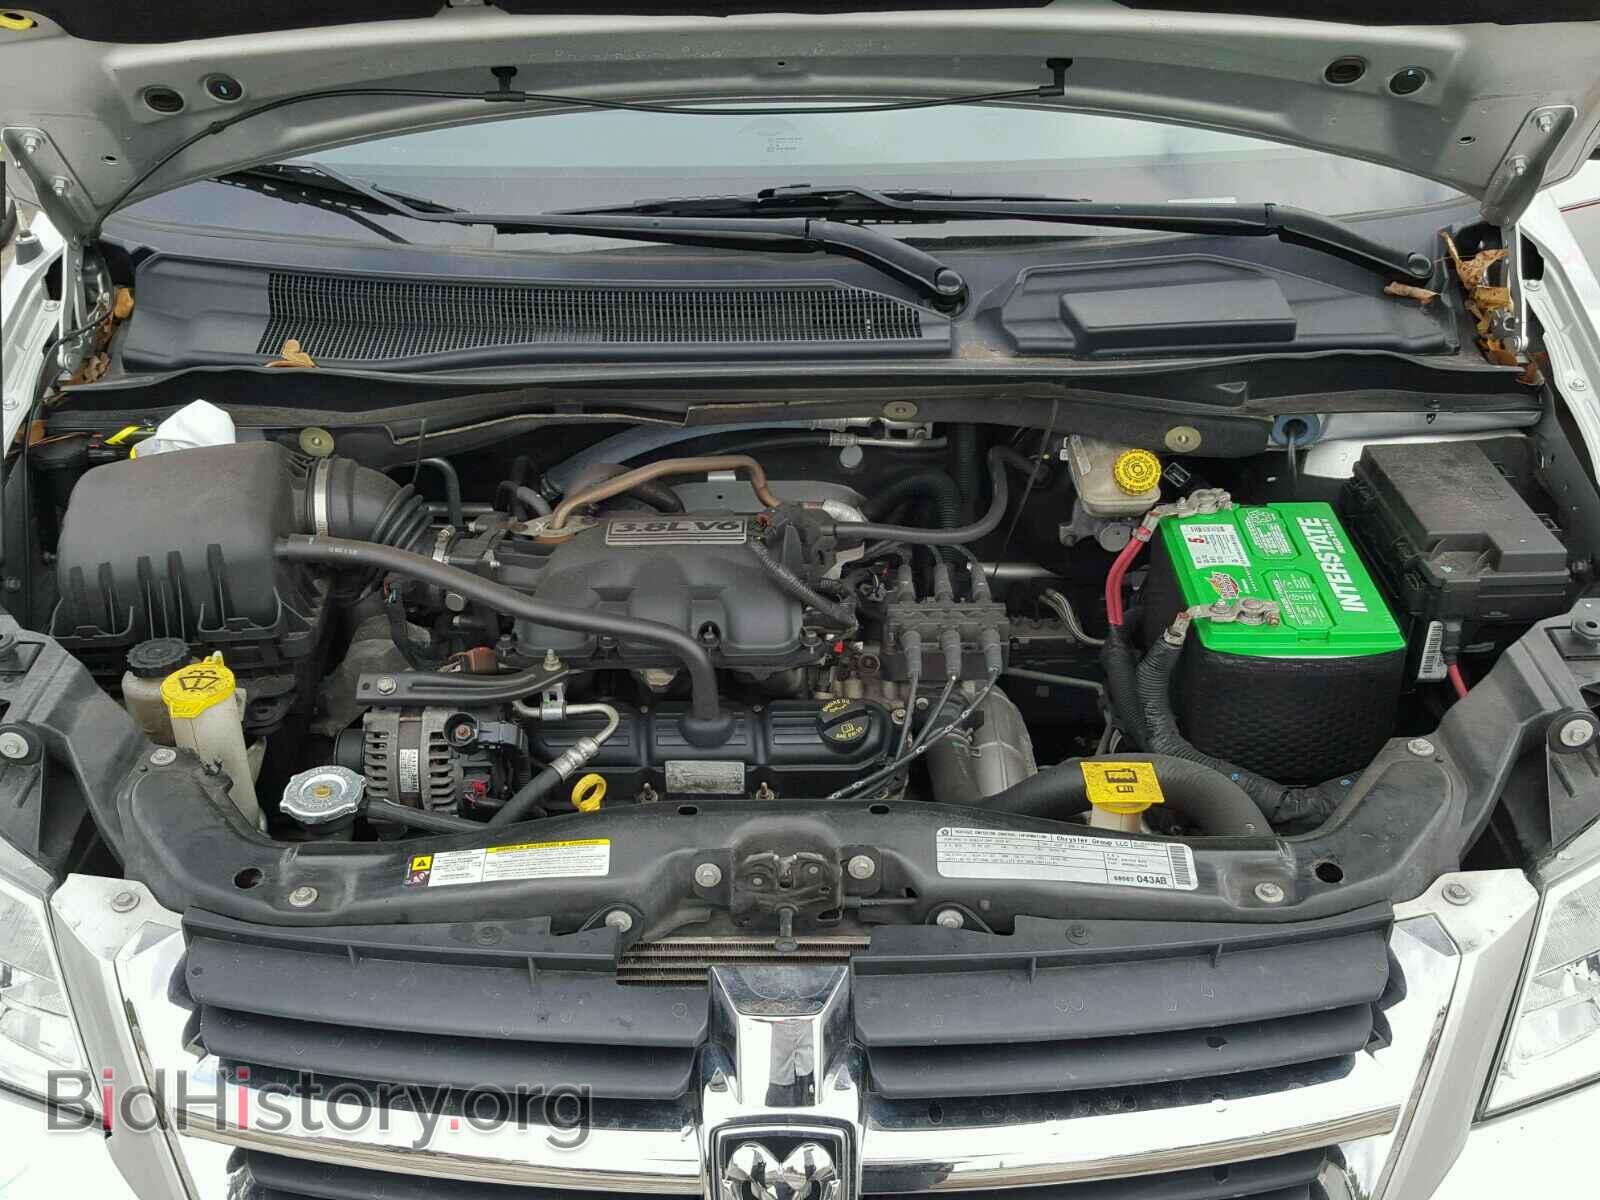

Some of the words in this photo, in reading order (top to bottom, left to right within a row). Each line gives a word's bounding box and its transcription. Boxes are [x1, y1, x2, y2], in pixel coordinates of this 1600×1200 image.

[694, 521, 740, 532] V6
[1296, 517, 1369, 613] INTERSTATE
[1056, 835, 1088, 845] Chrysler
[1091, 838, 1113, 847] Group
[1136, 875, 1168, 885] 043AB
